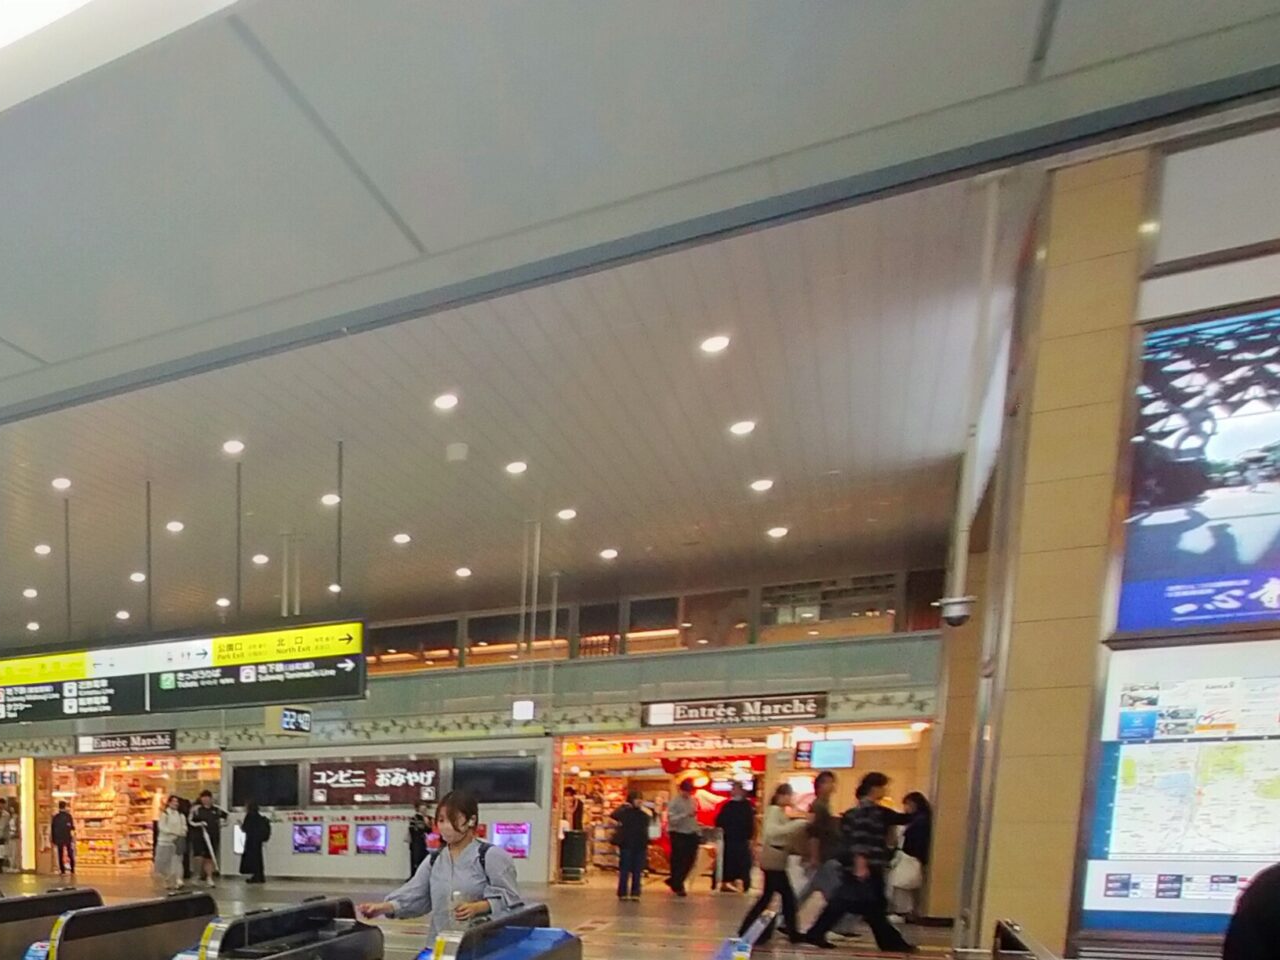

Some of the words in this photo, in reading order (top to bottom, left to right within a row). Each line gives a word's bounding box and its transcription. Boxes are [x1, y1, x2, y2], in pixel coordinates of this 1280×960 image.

[276, 646, 296, 655] North
[297, 644, 311, 653] Exit
[674, 702, 738, 719] Entrée
[742, 698, 818, 715] Marché
[281, 710, 311, 731] 22:40
[130, 734, 171, 747] Marché
[312, 769, 366, 785] コンビニ
[374, 770, 436, 787] おみやげ
